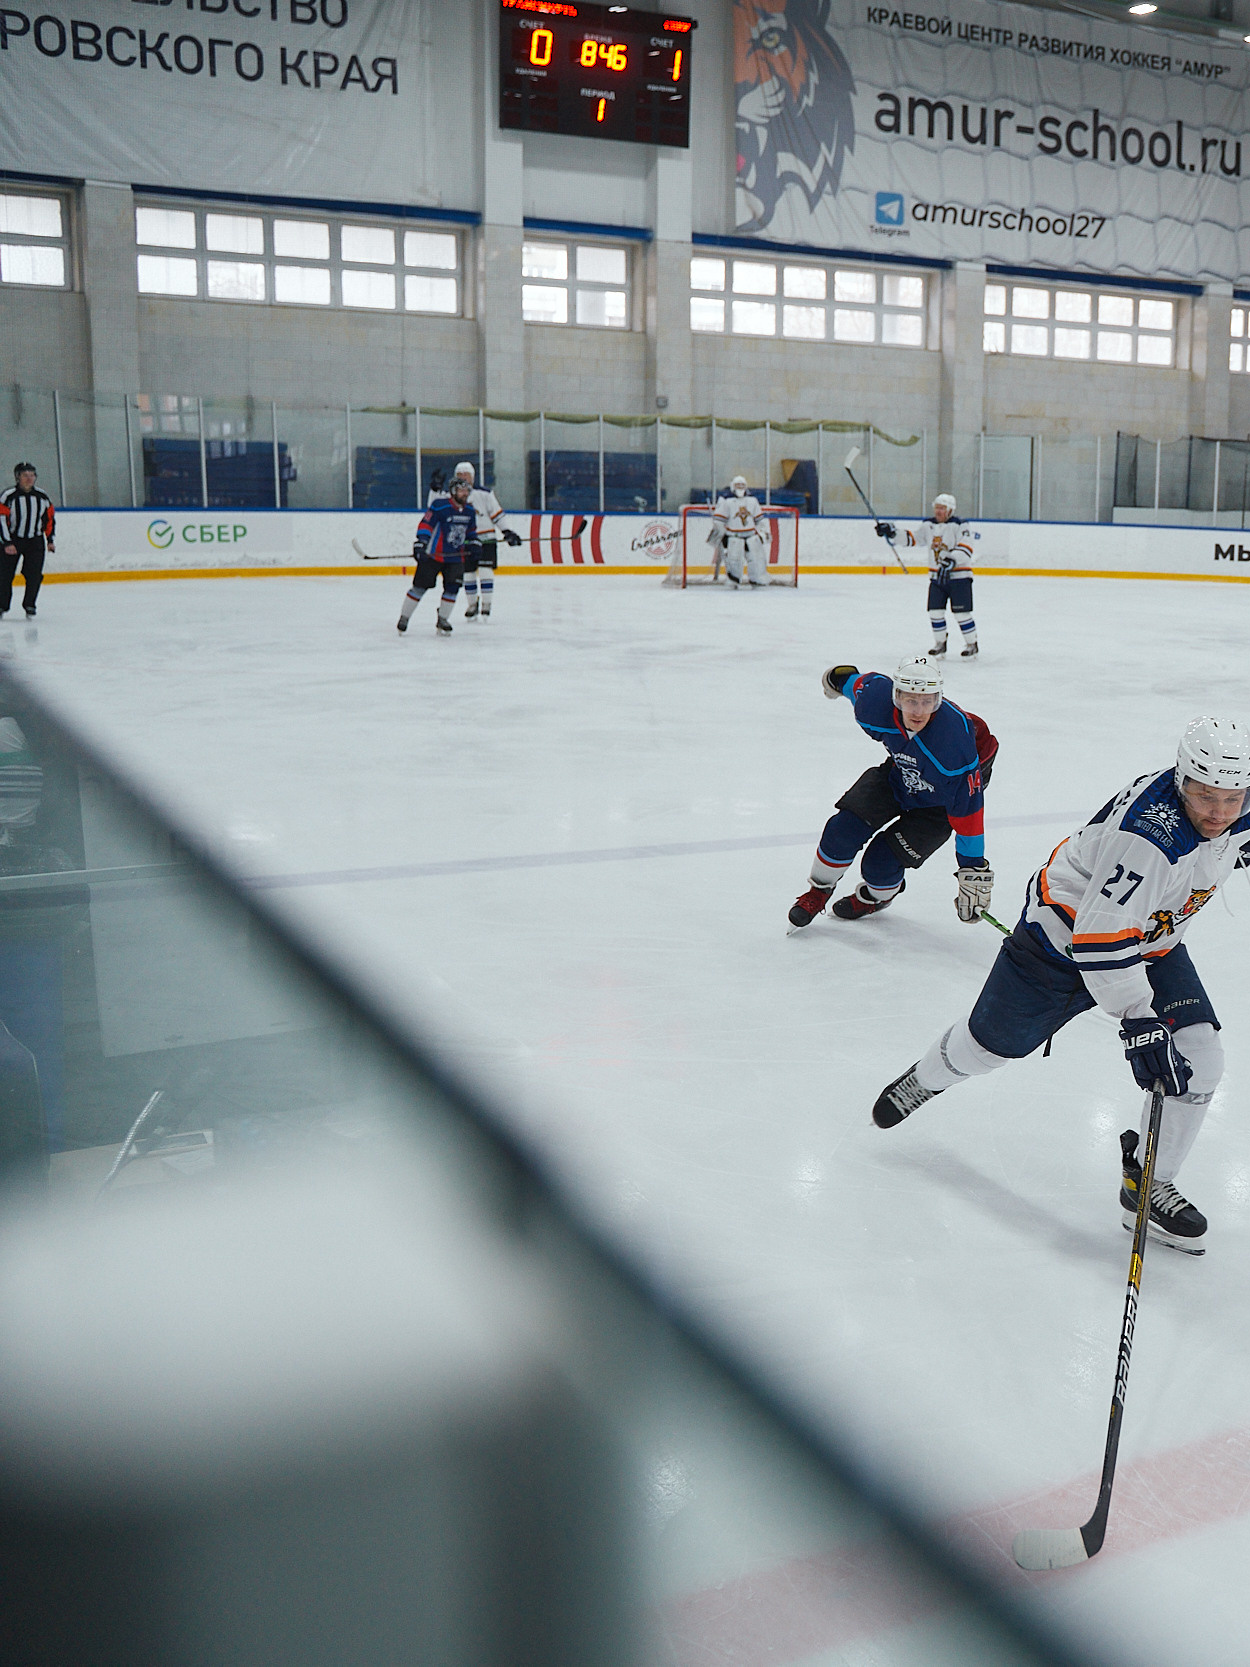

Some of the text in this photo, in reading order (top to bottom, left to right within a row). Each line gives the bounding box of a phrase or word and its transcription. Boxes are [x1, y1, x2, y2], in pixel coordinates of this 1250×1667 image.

[0, 8, 399, 95] РОВСКОГО КРАЯ
[530, 29, 554, 66] 0
[866, 7, 952, 36] КРАЕВОЙ
[957, 24, 1014, 46] ЦЕНТР
[1018, 33, 1106, 62] РАЗВИТИЯ
[1109, 48, 1171, 72] ХОККЕЯ
[672, 49, 683, 81] 1
[596, 98, 606, 123] 1
[875, 92, 1241, 176] amur-school.ru
[869, 225, 910, 237] Telegram
[912, 202, 1107, 239] amurschool27
[182, 525, 247, 543] СБЕР
[1133, 819, 1174, 849] UNITED FAR EAST
[1100, 864, 1144, 906] 27
